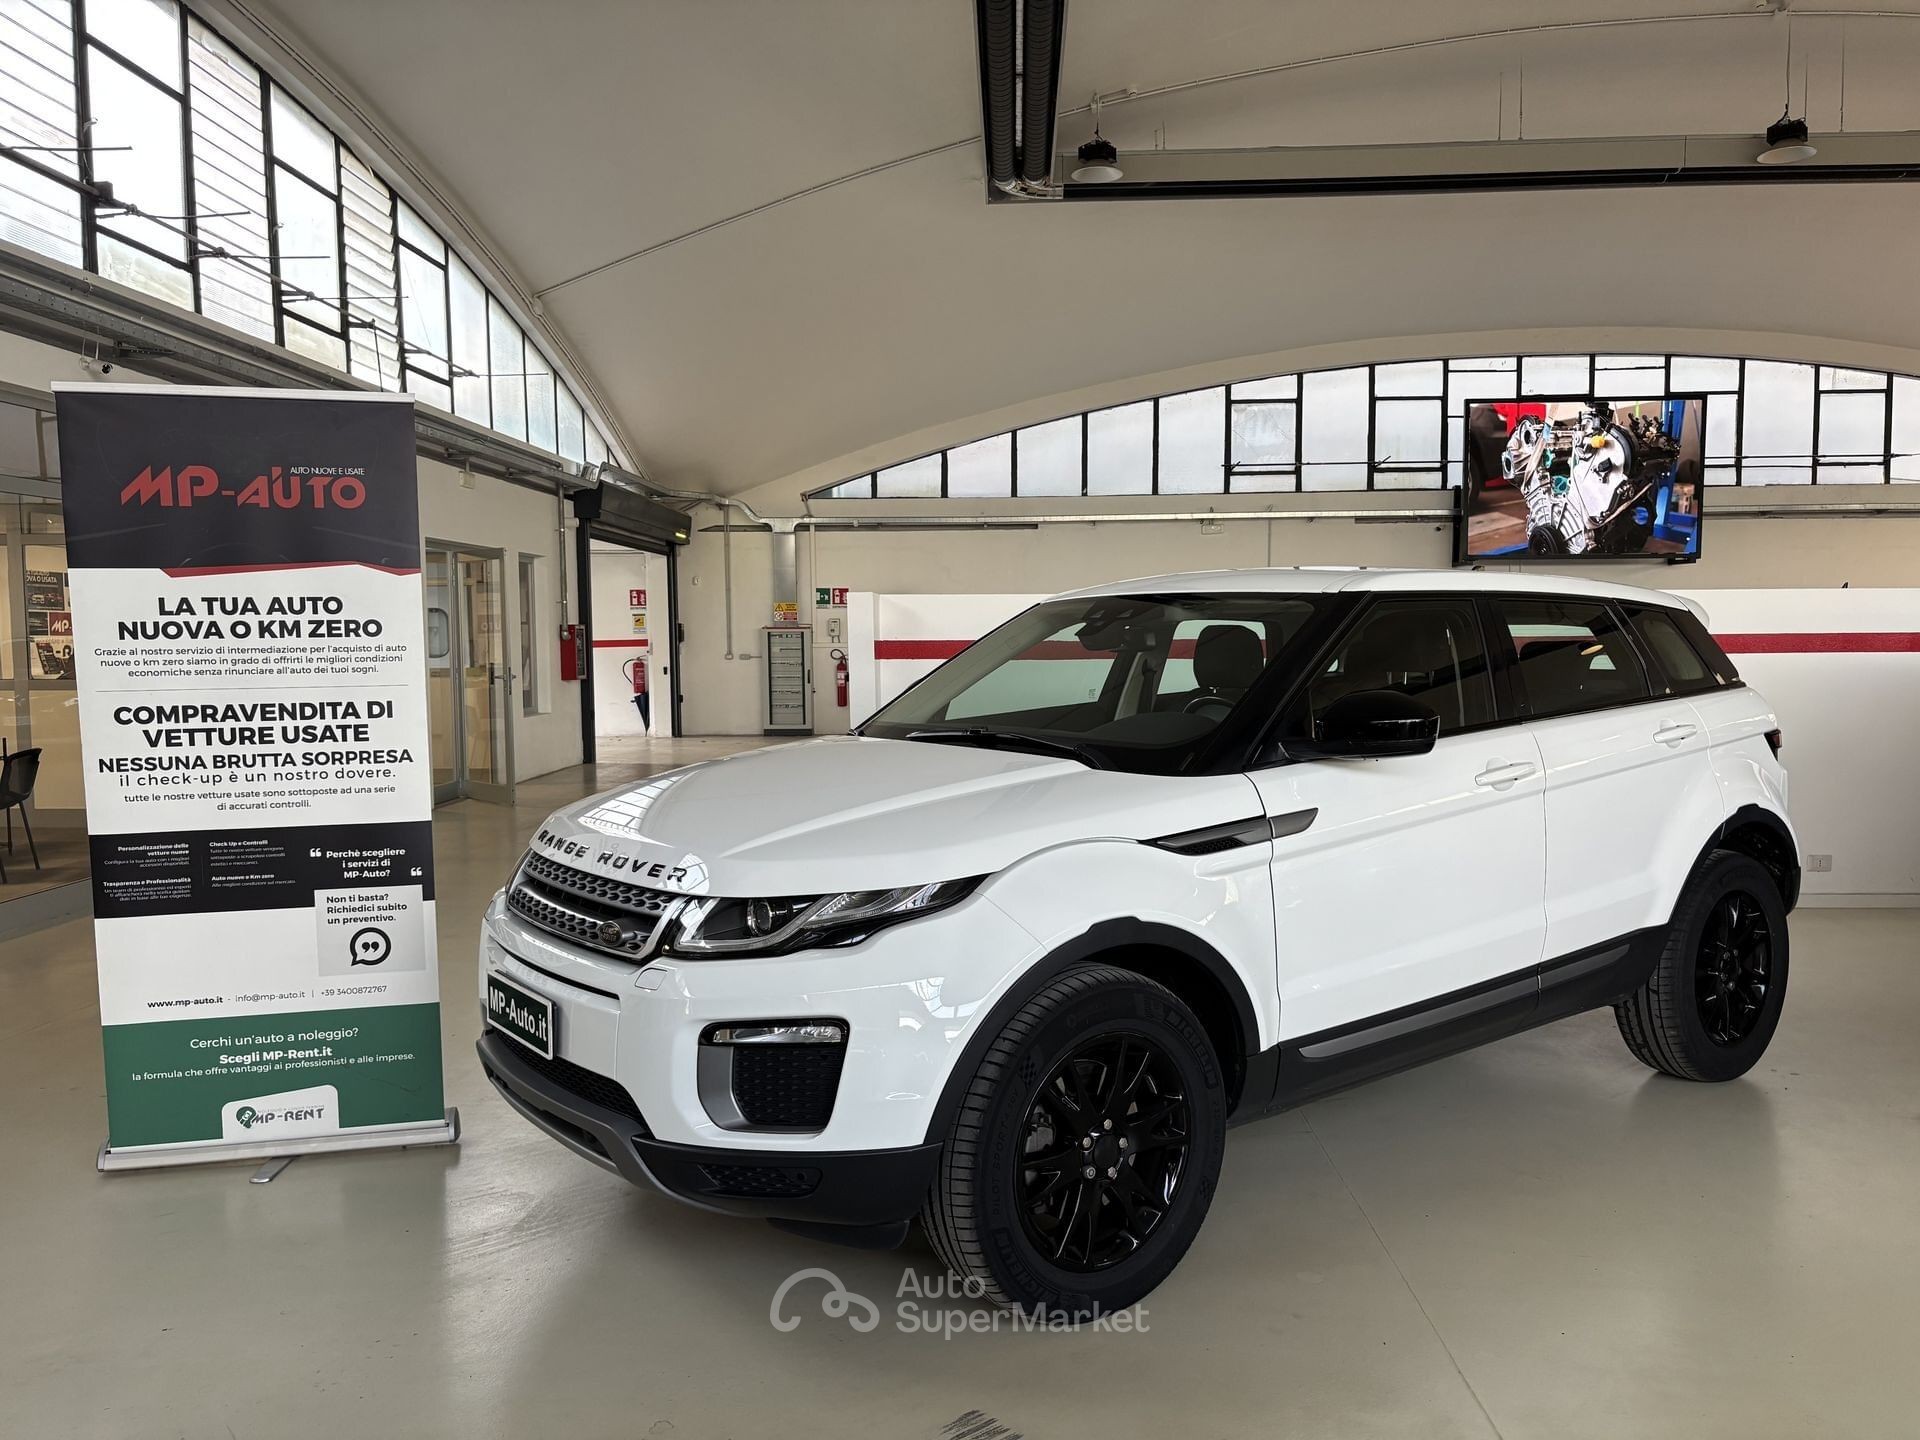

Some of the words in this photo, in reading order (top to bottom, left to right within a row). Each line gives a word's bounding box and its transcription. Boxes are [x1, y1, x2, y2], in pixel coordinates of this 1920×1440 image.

[311, 467, 337, 475] NUOVE
[121, 465, 366, 509] MP-AUTO
[158, 597, 197, 616] LA
[201, 596, 261, 616] TUA
[266, 596, 343, 615] AUTO
[118, 620, 225, 640] NUOVA
[230, 620, 252, 639] O
[258, 619, 301, 639] KM
[307, 619, 383, 638] ZERO
[94, 648, 127, 656] Grazie
[129, 647, 138, 656] al
[141, 648, 173, 656] nostro
[175, 647, 213, 655] servizio
[215, 646, 225, 654] di
[227, 645, 308, 654] intermediazione
[310, 647, 325, 657] per
[328, 645, 372, 657] l'acquisto
[374, 644, 383, 652] di
[143, 658, 159, 666] km
[187, 657, 217, 666] siamo
[220, 657, 228, 665] in
[231, 657, 259, 667] grado
[262, 656, 271, 664] di
[274, 655, 303, 664] offrirti
[306, 655, 314, 664] le
[316, 655, 352, 666] migliori
[354, 654, 403, 663] condizioni
[128, 668, 192, 677] economiche
[225, 668, 274, 676] rinunciare
[314, 666, 328, 674] dei
[331, 665, 349, 673] tuoi
[351, 665, 379, 674] sogni.
[114, 702, 361, 725] COMPRAVENDITA
[367, 700, 393, 719] DI
[142, 726, 275, 748] VETTURE
[282, 724, 370, 744] USATE
[98, 755, 208, 773] NESSUNA
[212, 752, 297, 769] BRUTTA
[302, 749, 414, 766] SORPRESA
[120, 774, 130, 787] il
[137, 773, 222, 786] check-up
[229, 771, 238, 782] è
[245, 772, 266, 782] un
[274, 770, 329, 781] nostro
[335, 768, 396, 779] dovere.
[124, 794, 149, 802] tutte
[152, 793, 161, 801] le
[198, 791, 232, 799] vetture
[288, 788, 338, 797] sottoposte
[340, 786, 352, 794] ad
[374, 785, 396, 793] serie
[217, 802, 227, 810] di
[229, 801, 267, 810] accurati
[270, 800, 311, 809] controlli.
[362, 848, 406, 858] scegliere
[537, 829, 590, 858] RANGE
[597, 850, 687, 883] ROVER
[347, 859, 379, 868] servizi
[381, 858, 391, 867] di
[344, 870, 391, 879] MP-Auto?
[326, 896, 347, 904] Non
[349, 894, 356, 902] ti
[358, 893, 389, 901] basta?
[327, 904, 375, 914] Richiedici
[377, 902, 407, 911] subito
[343, 914, 396, 925] preventivo.
[148, 996, 223, 1008] www.mp-auto.it
[236, 991, 305, 1002] info@mp-auto.it
[337, 985, 387, 996] 3400872767
[490, 986, 547, 1042] MP-Auto.it
[190, 1036, 232, 1048] Cerchi
[235, 1033, 284, 1045] un'auto
[298, 1027, 359, 1041] noleggio?
[220, 1051, 260, 1064] Scegli
[263, 1046, 333, 1061] MP-Rent.it
[132, 1073, 141, 1081] la
[144, 1070, 182, 1080] formula
[185, 1069, 203, 1077] che
[205, 1067, 228, 1076] offre
[230, 1062, 272, 1073] vantaggi
[274, 1062, 282, 1070] ai
[285, 1057, 347, 1070] professionisti
[357, 1055, 374, 1063] alle
[376, 1053, 415, 1062] imprese.
[252, 1108, 324, 1124] MP-RENT
